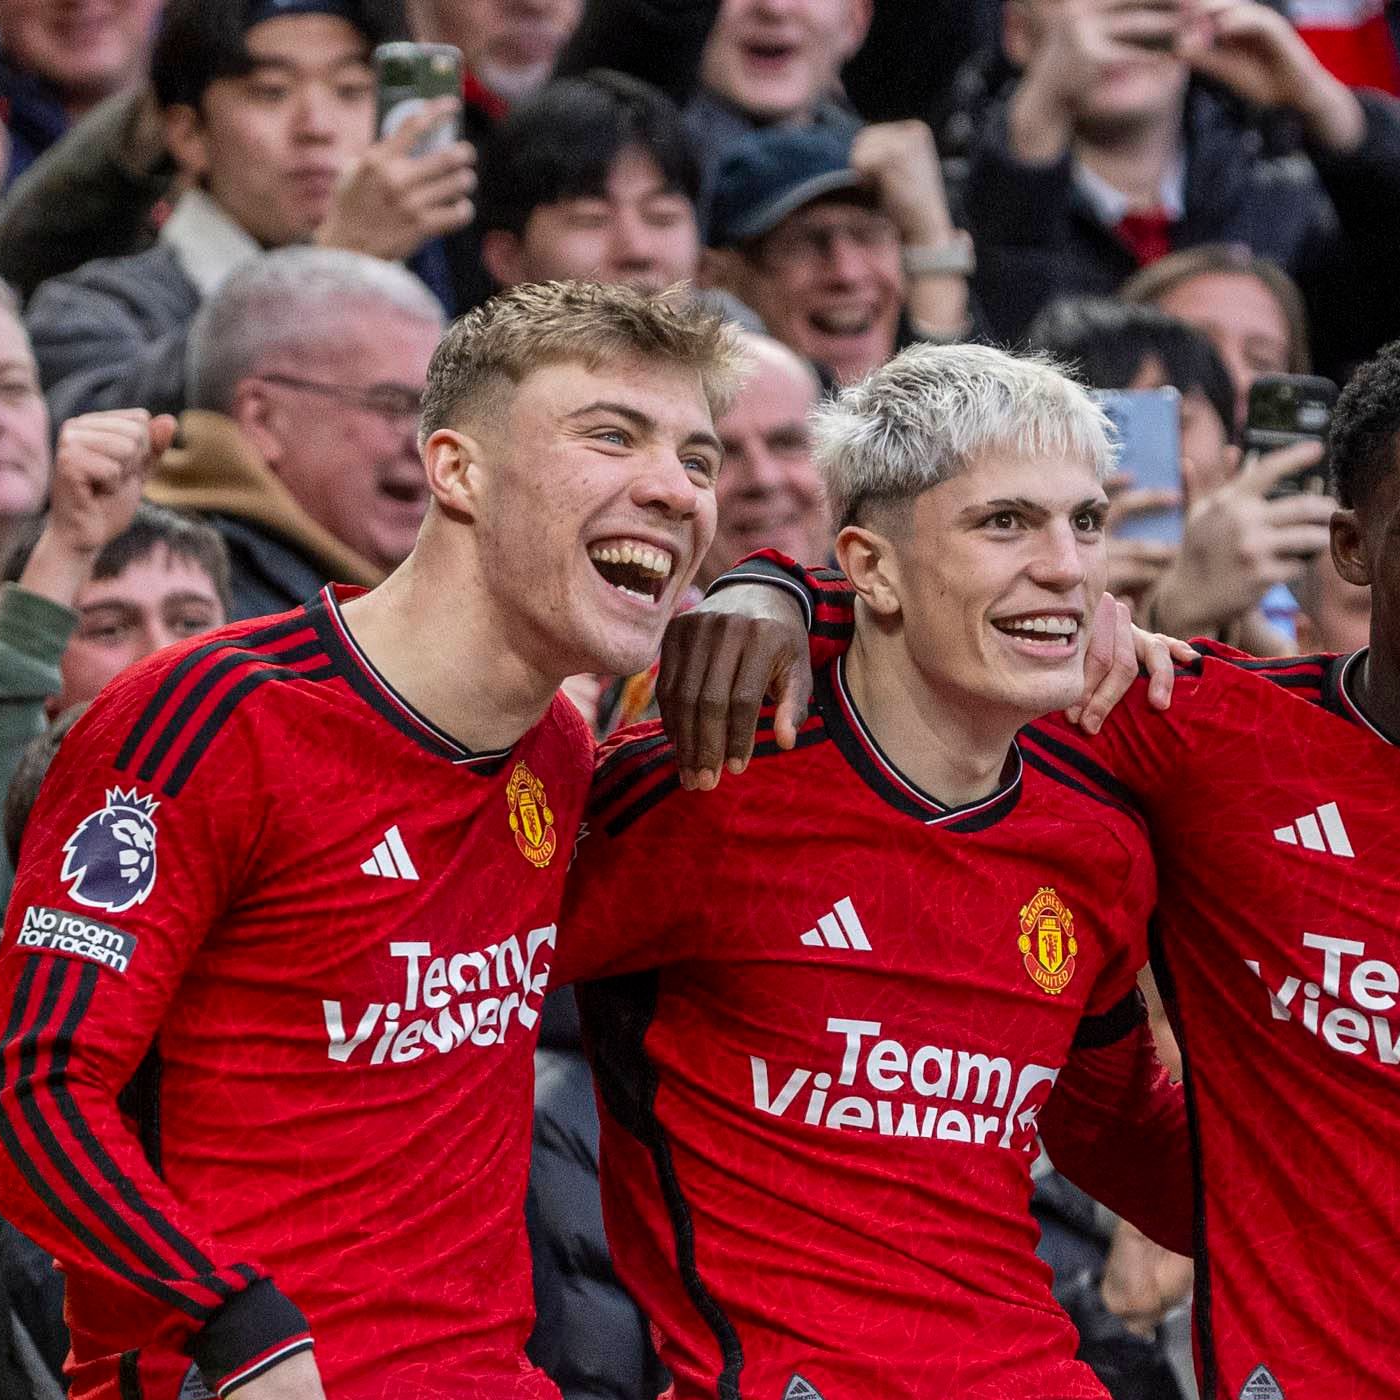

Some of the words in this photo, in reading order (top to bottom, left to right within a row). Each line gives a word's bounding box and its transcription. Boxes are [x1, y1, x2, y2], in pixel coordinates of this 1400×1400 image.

[16, 924, 51, 946] for
[49, 932, 128, 973] racism
[23, 905, 57, 931] No
[58, 916, 125, 952] room
[391, 935, 525, 1010] Team
[1035, 969, 1069, 988] UNITED
[323, 992, 519, 1064] Viewer
[826, 1017, 1013, 1108] Team
